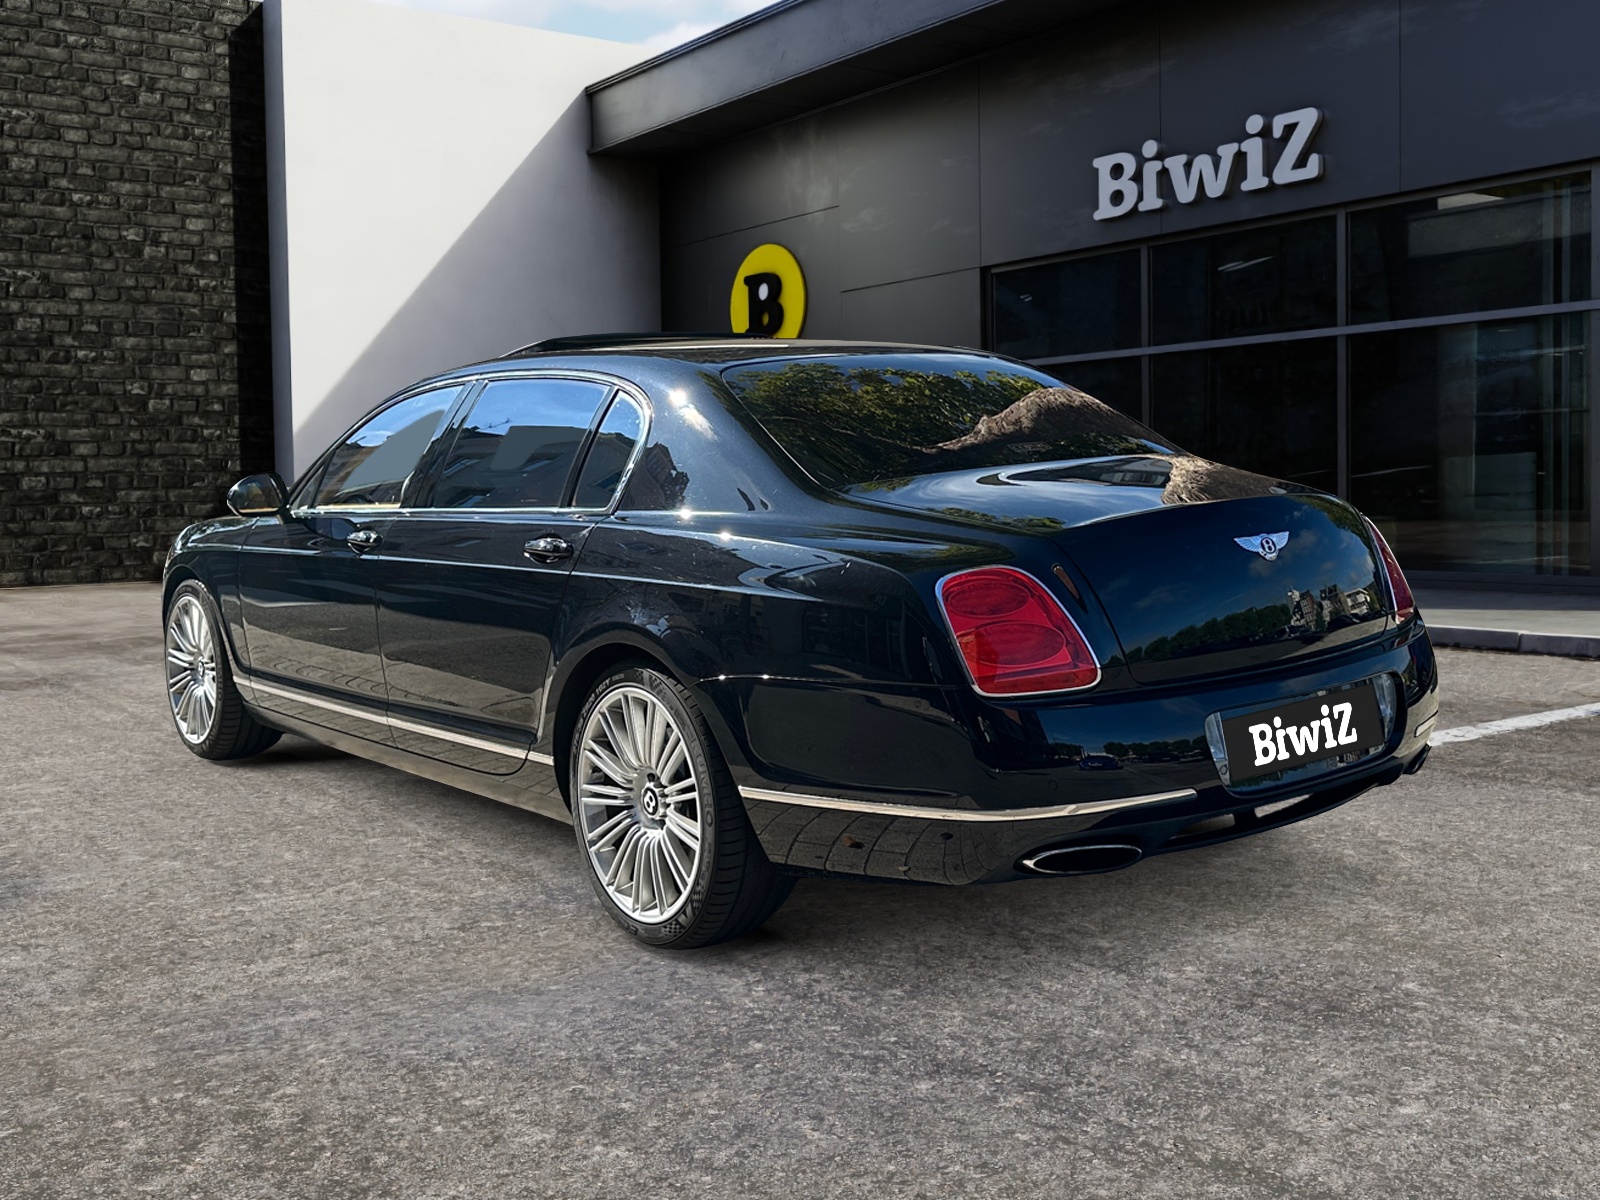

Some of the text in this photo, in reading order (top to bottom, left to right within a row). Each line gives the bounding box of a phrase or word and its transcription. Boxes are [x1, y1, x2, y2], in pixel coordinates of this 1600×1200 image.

[1092, 107, 1321, 221] BiwiZ
[743, 272, 785, 338] B
[1248, 702, 1358, 767] BiwiZ
